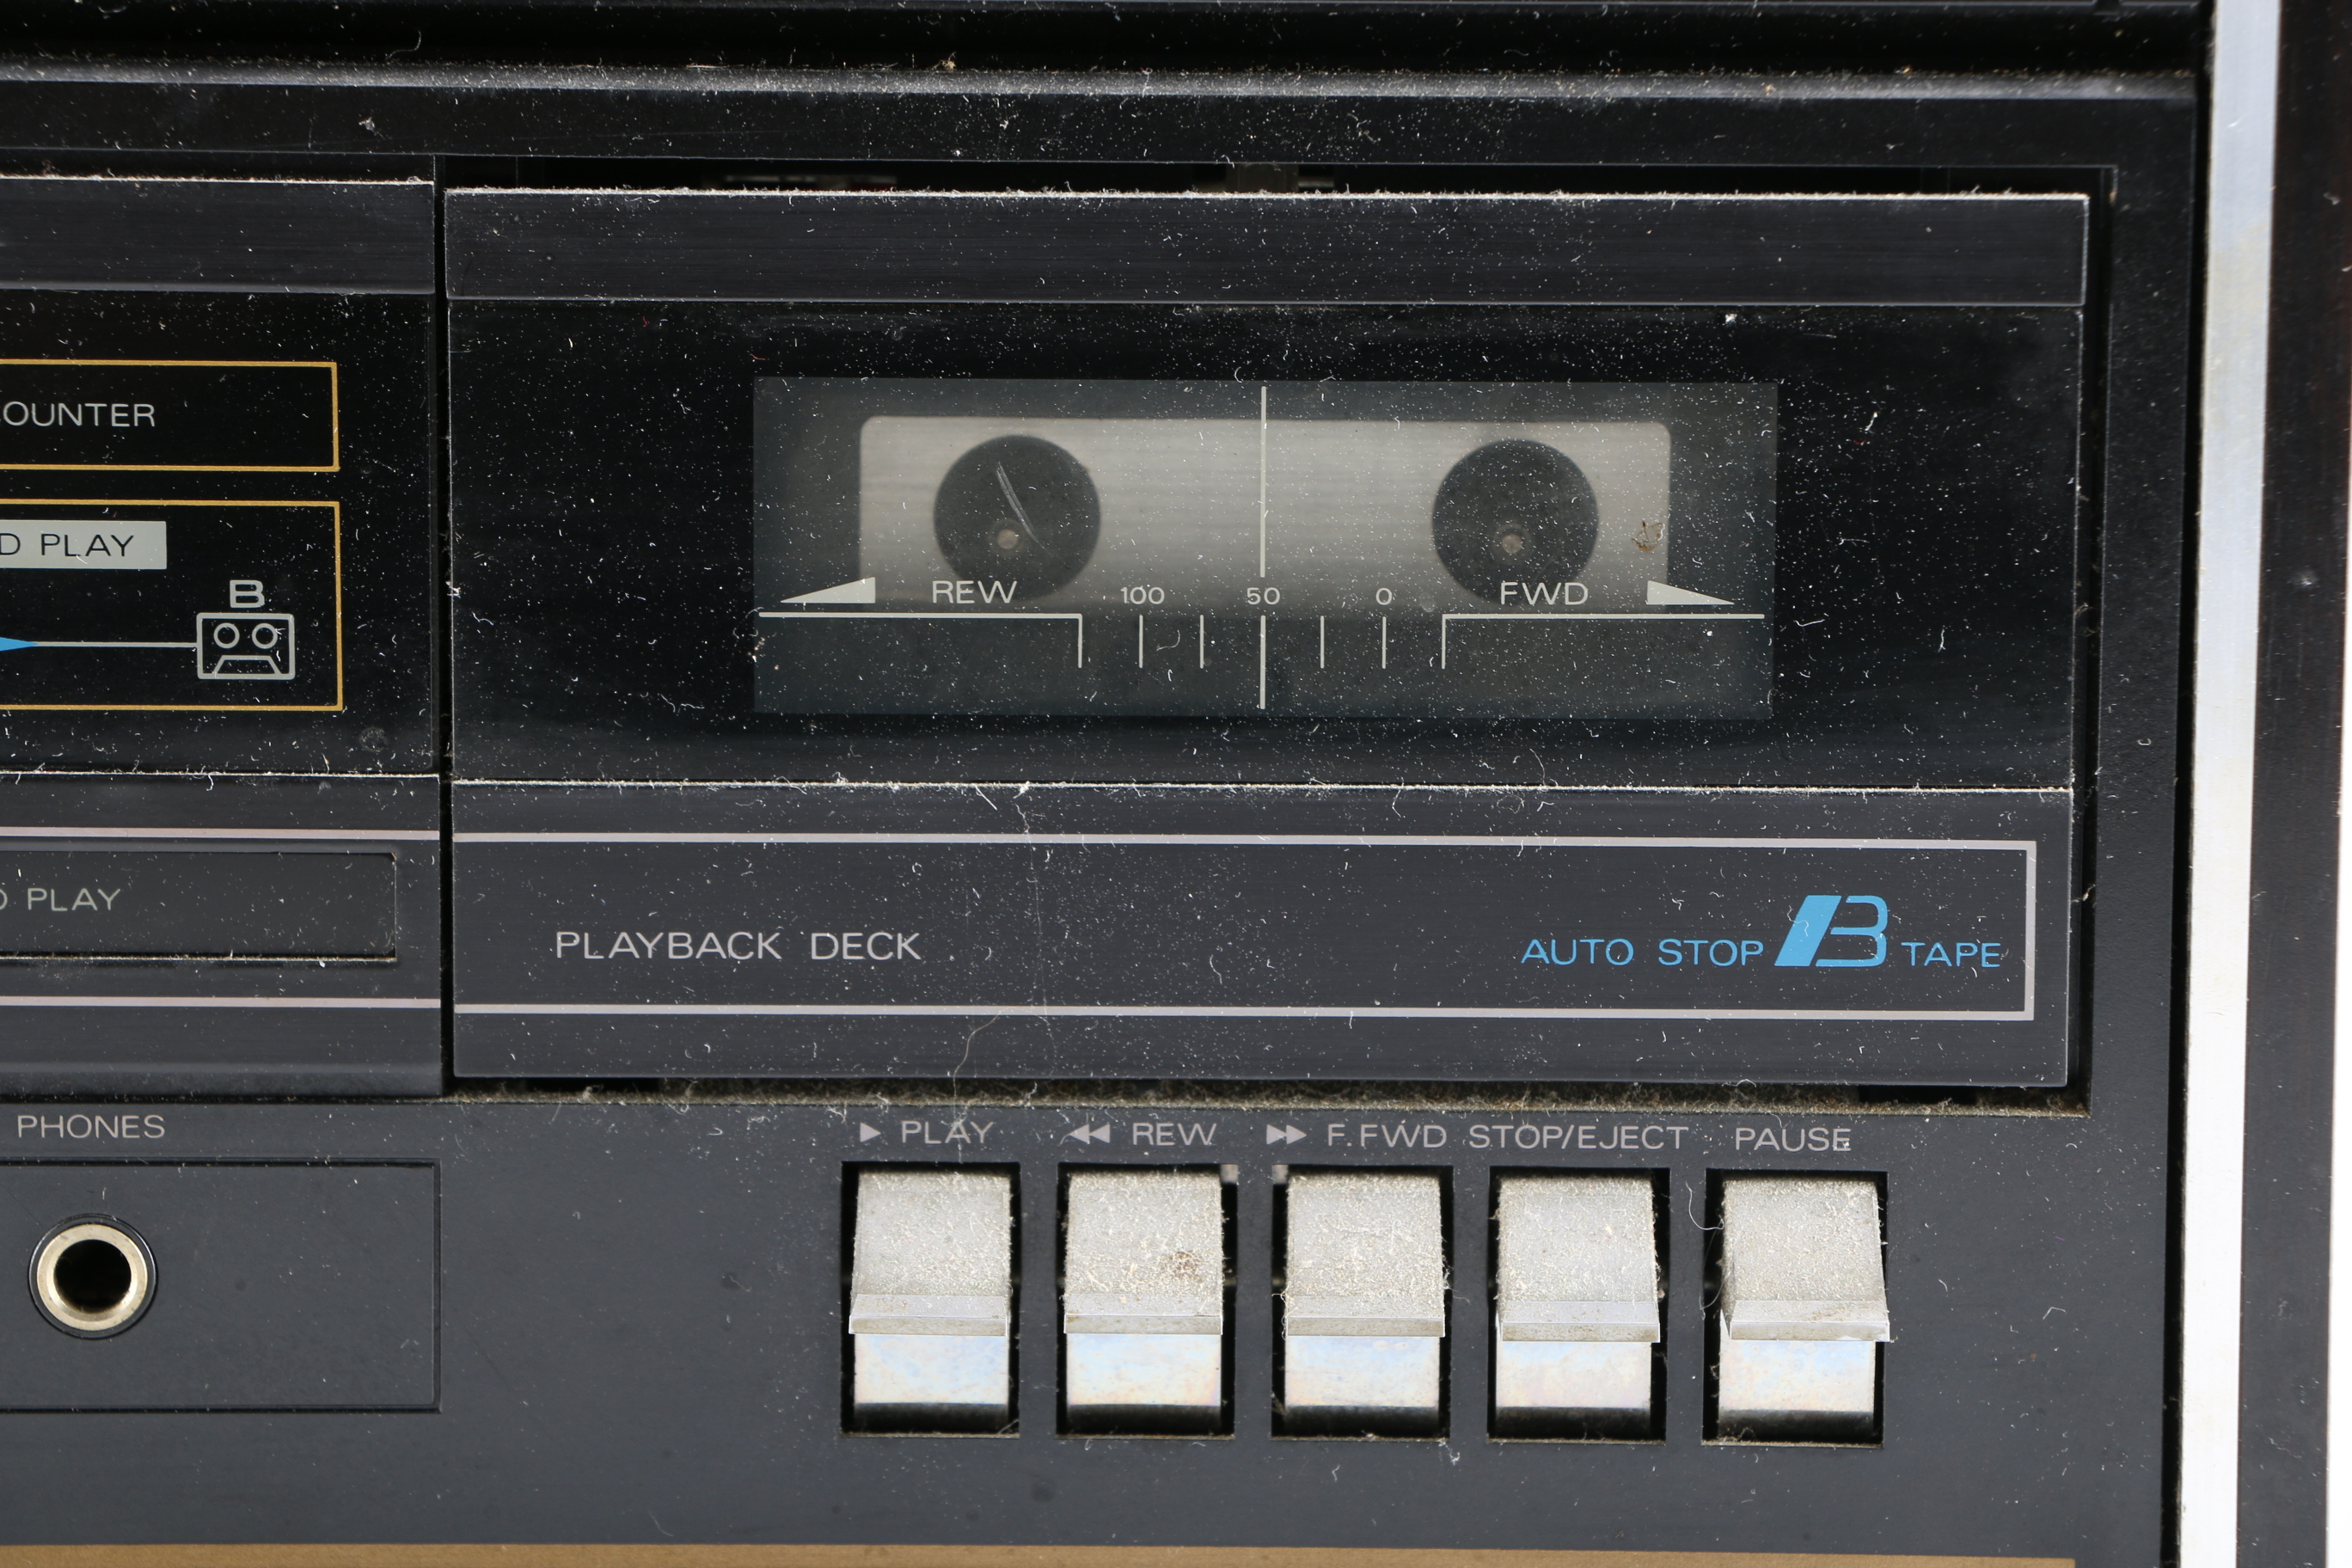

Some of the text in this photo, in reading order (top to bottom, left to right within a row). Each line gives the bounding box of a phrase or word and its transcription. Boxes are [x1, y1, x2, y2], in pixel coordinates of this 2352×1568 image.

[40, 534, 134, 557] PLAY
[230, 579, 266, 609] B
[932, 580, 1017, 604] REW
[1121, 586, 1166, 605] 100
[1246, 587, 1280, 605] 50
[1500, 582, 1589, 605] FWD
[28, 888, 121, 911] PLAY
[556, 931, 922, 960] PLAYBACK DECK
[1522, 938, 1633, 965] AUTO
[1658, 939, 1763, 966] STOP
[1902, 941, 2001, 968] TAPE
[17, 1114, 166, 1139] PHONES
[901, 1121, 994, 1145] PLAY
[1133, 1123, 1216, 1146] REW
[1469, 1124, 1689, 1150] STOP/EJECT
[1736, 1127, 1853, 1153] PAUSE
